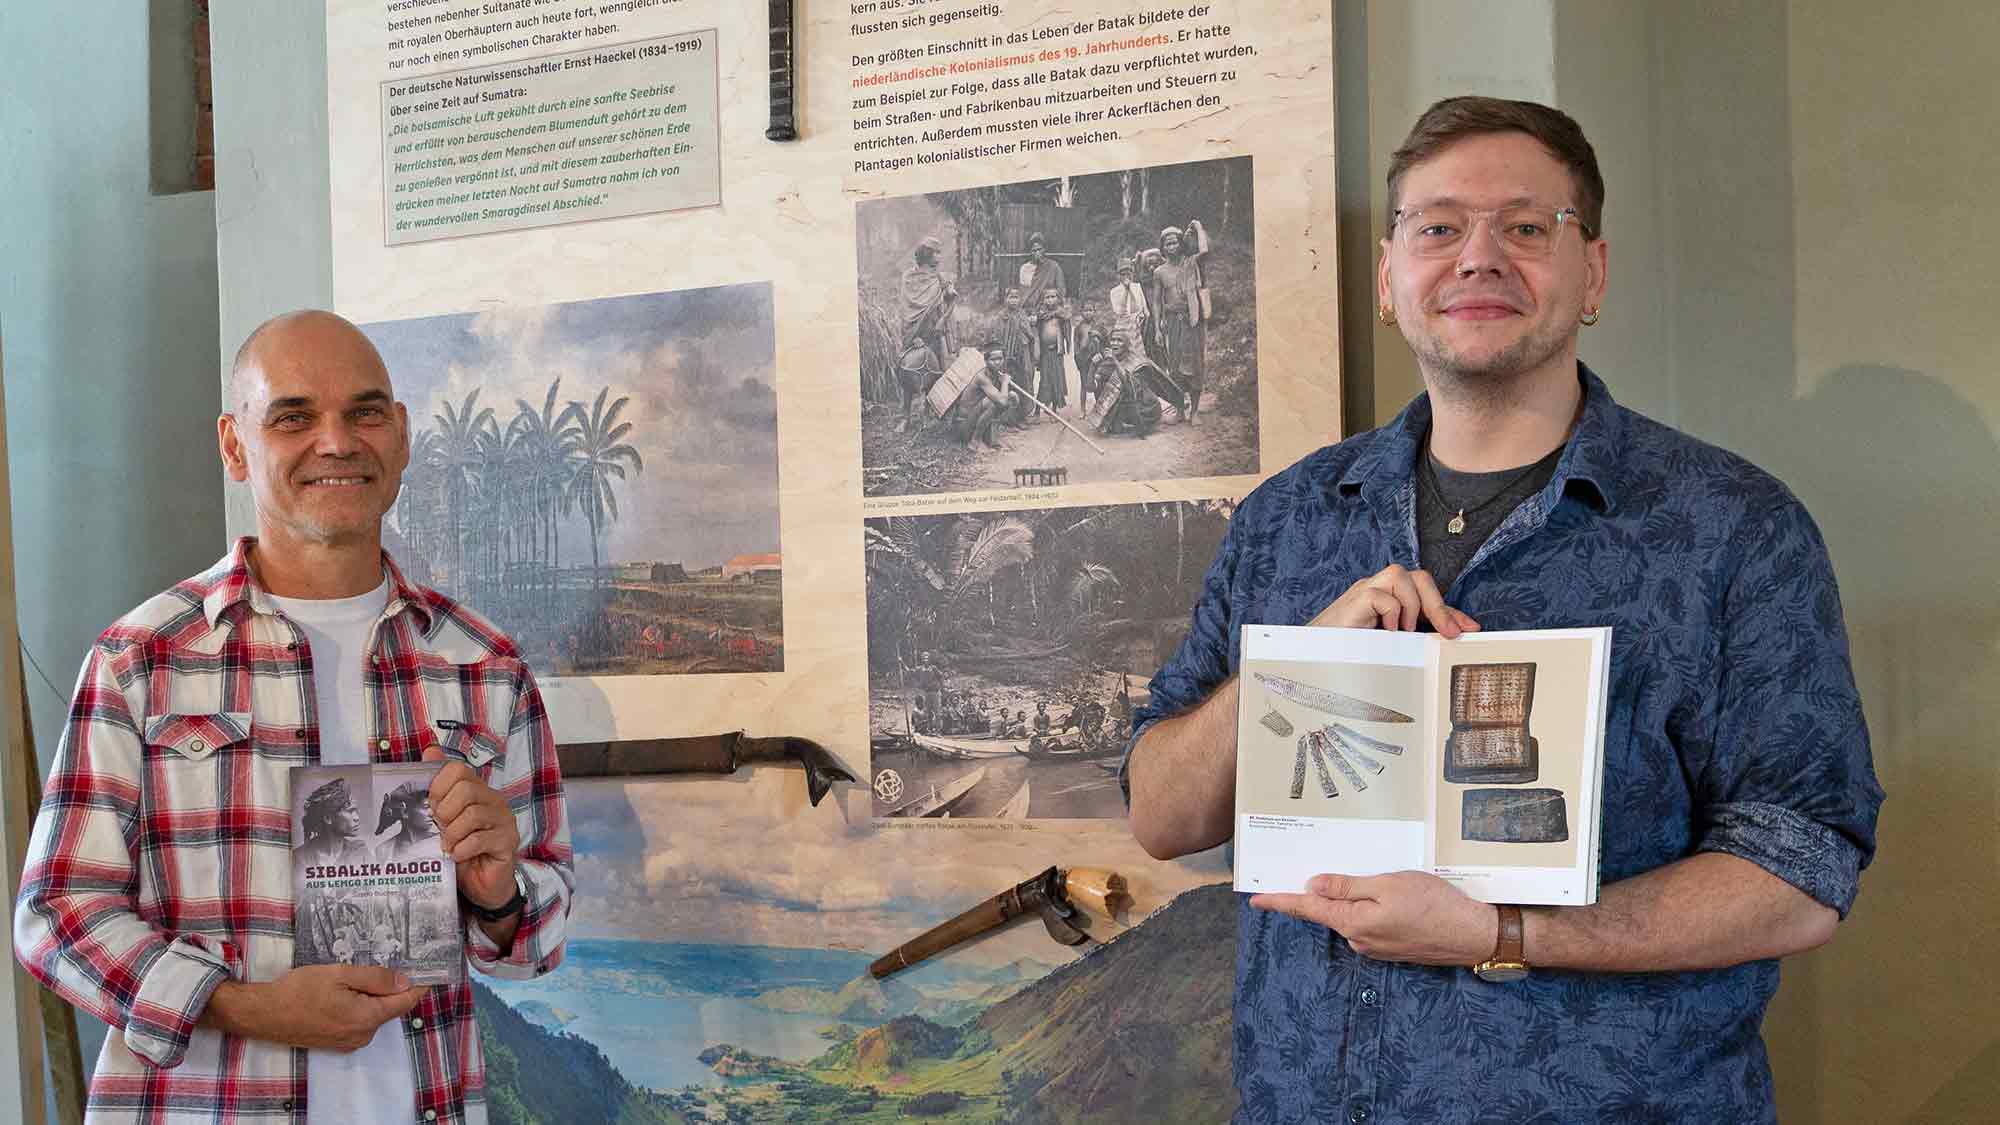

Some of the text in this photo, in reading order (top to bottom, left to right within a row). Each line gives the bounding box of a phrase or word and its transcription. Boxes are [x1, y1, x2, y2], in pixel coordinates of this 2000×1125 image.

[388, 16, 432, 32] bestehen
[434, 8, 480, 25] nebenher
[482, 0, 532, 15] Sultanate
[388, 39, 404, 50] mit
[406, 32, 442, 49] royalen
[444, 22, 512, 42] Oberhäuptern
[514, 16, 540, 29] auch
[542, 12, 572, 24] heute
[574, 6, 597, 19] fort,
[850, 3, 876, 15] kern
[850, 3, 1003, 36] flussten sich gegenseitig.
[388, 24, 620, 70] nur noch einen symbolischen Charakter haben.
[852, 5, 1209, 67] Den größten Einschnitt in das Leben der Batak bildete der
[852, 24, 1231, 88] niederländische Kolonialismus des 19. Jahrhunderts. Er hatte
[389, 87, 406, 97] Der
[408, 80, 453, 95] deutsche
[455, 62, 562, 87] Naturwissenschaftler
[564, 56, 592, 70] Ernst
[594, 48, 636, 64] Haeckel
[852, 45, 1257, 109] zum Beispiel zur Folge, dass alle Batak dazu verpflichtet wurden,
[390, 88, 527, 117] über seine Zeit auf Sumatra:
[410, 115, 472, 132] balsamische
[474, 111, 495, 123] Luft
[496, 104, 536, 122] gekühlt
[537, 100, 567, 114] durch
[568, 97, 591, 108] eine
[593, 91, 627, 105] sanfte
[629, 84, 675, 100] Seebrise
[853, 71, 1236, 130] beim Straßen- und Fabrikenbau mitzuarbeiten und Steuern zu
[854, 94, 1220, 151] entrichten. Außerdem mussten viele ihrer Ackerflächen den
[393, 103, 687, 154] und erfüllt von berauschendem Blumenduft gehört zu dem
[394, 122, 691, 174] Herrlichsten, was dem Menschen auf unserer schönen Erde
[854, 131, 1121, 172] Plantagen kolonialistischer Firmen weichen.
[394, 184, 406, 192] zu
[408, 176, 452, 193] genießen
[454, 169, 498, 184] vergönnt
[500, 167, 517, 178] ist,
[519, 161, 540, 175] und
[541, 160, 560, 173] mit
[560, 157, 598, 170] diesem
[600, 146, 671, 164] zauberhaften
[395, 166, 680, 211] drücken meiner letzten Nacht auf Sumatra nahm ich von
[396, 220, 412, 230] der
[414, 211, 479, 228] wundervollen
[481, 200, 550, 219] Smaragdinsel
[305, 860, 442, 879] SIBALIK ALOGO
[306, 875, 442, 889] AUS LEMGO IN DIE KOLONIE
